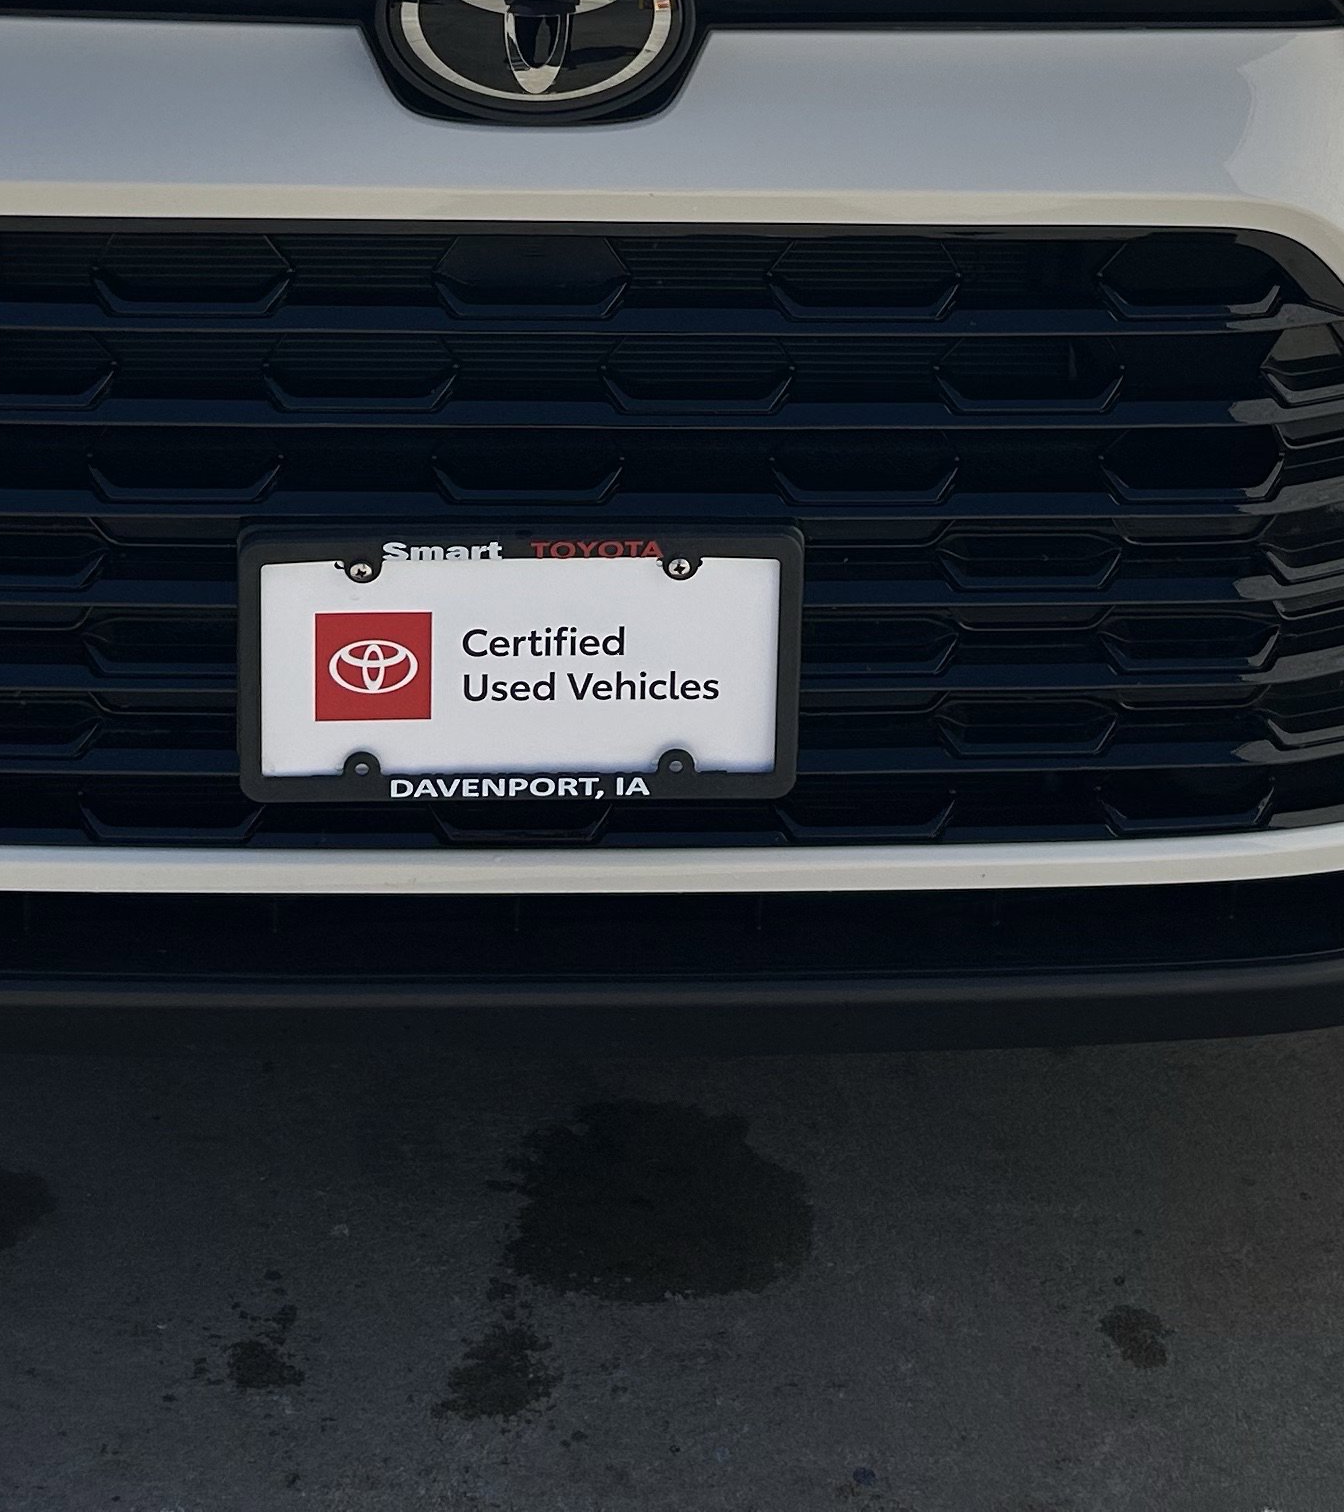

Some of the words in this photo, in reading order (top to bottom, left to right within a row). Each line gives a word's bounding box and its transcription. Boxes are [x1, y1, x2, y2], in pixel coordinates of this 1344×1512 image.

[381, 540, 504, 562] Smart
[530, 539, 664, 559] TOYOTA
[461, 626, 627, 659] Certified
[462, 671, 557, 703] Used
[566, 671, 721, 701] Vehicles
[389, 777, 605, 800] DAVENPORT,
[614, 777, 651, 797] IA
